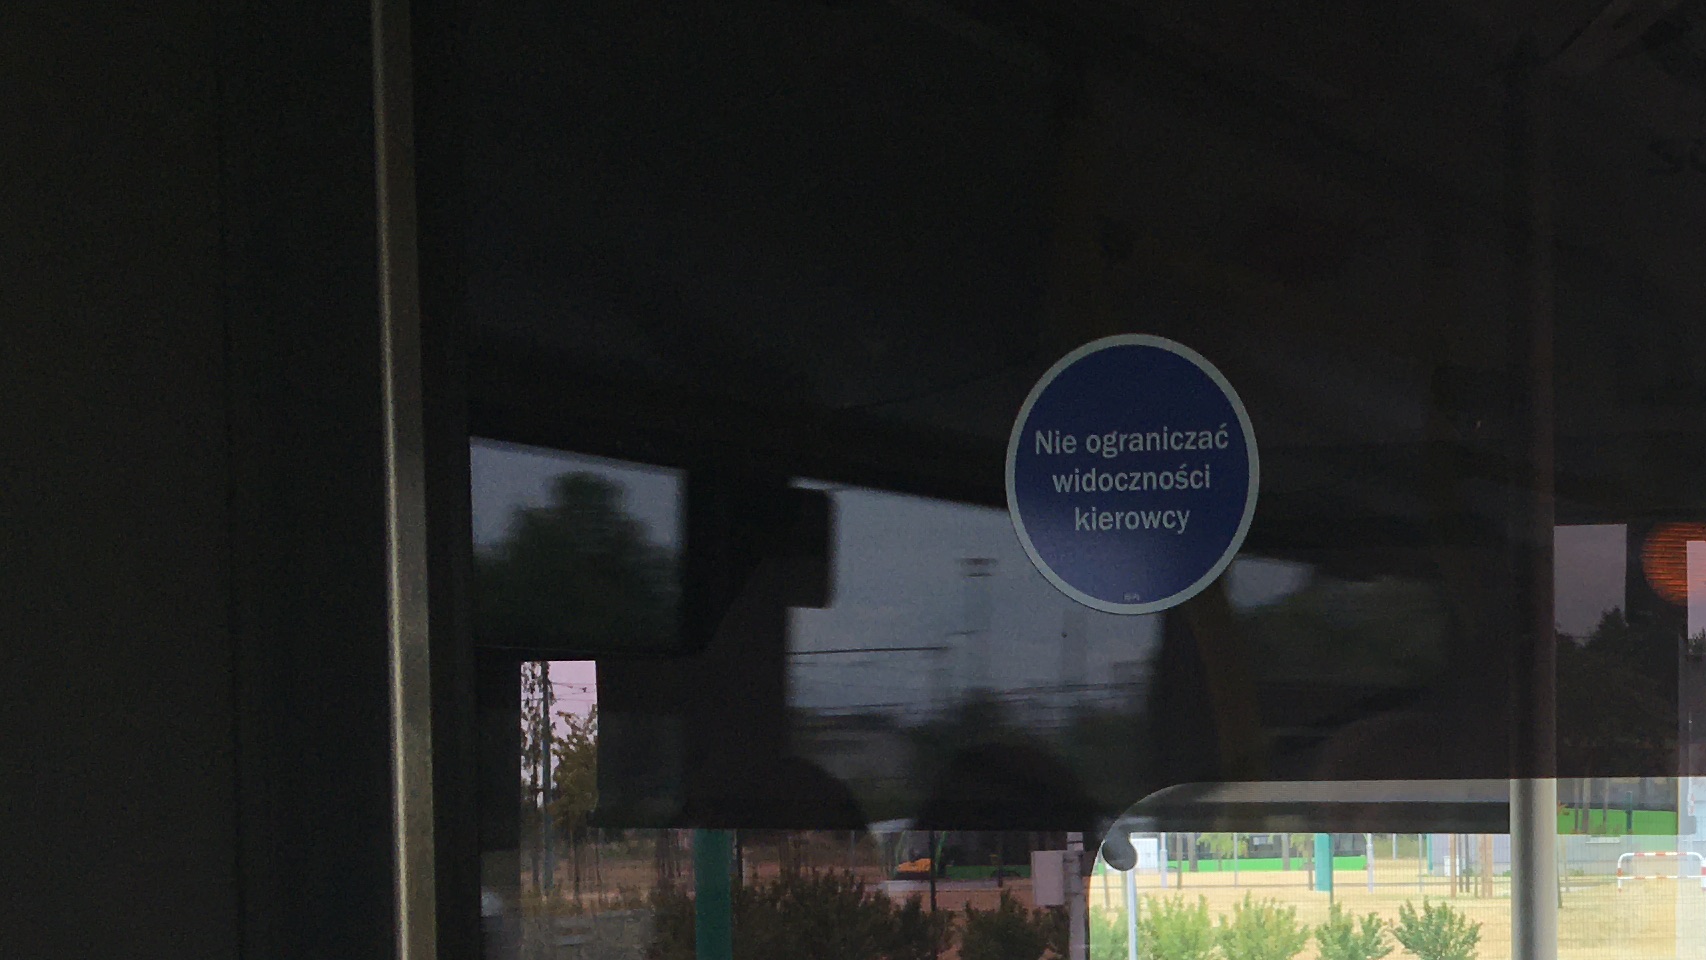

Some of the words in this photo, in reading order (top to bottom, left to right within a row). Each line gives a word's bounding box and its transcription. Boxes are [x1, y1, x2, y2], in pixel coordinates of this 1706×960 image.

[1034, 429, 1077, 455] Nie
[1085, 422, 1230, 458] ograniczać
[1052, 463, 1211, 493] widoczności
[1074, 506, 1191, 535] kierowcy
